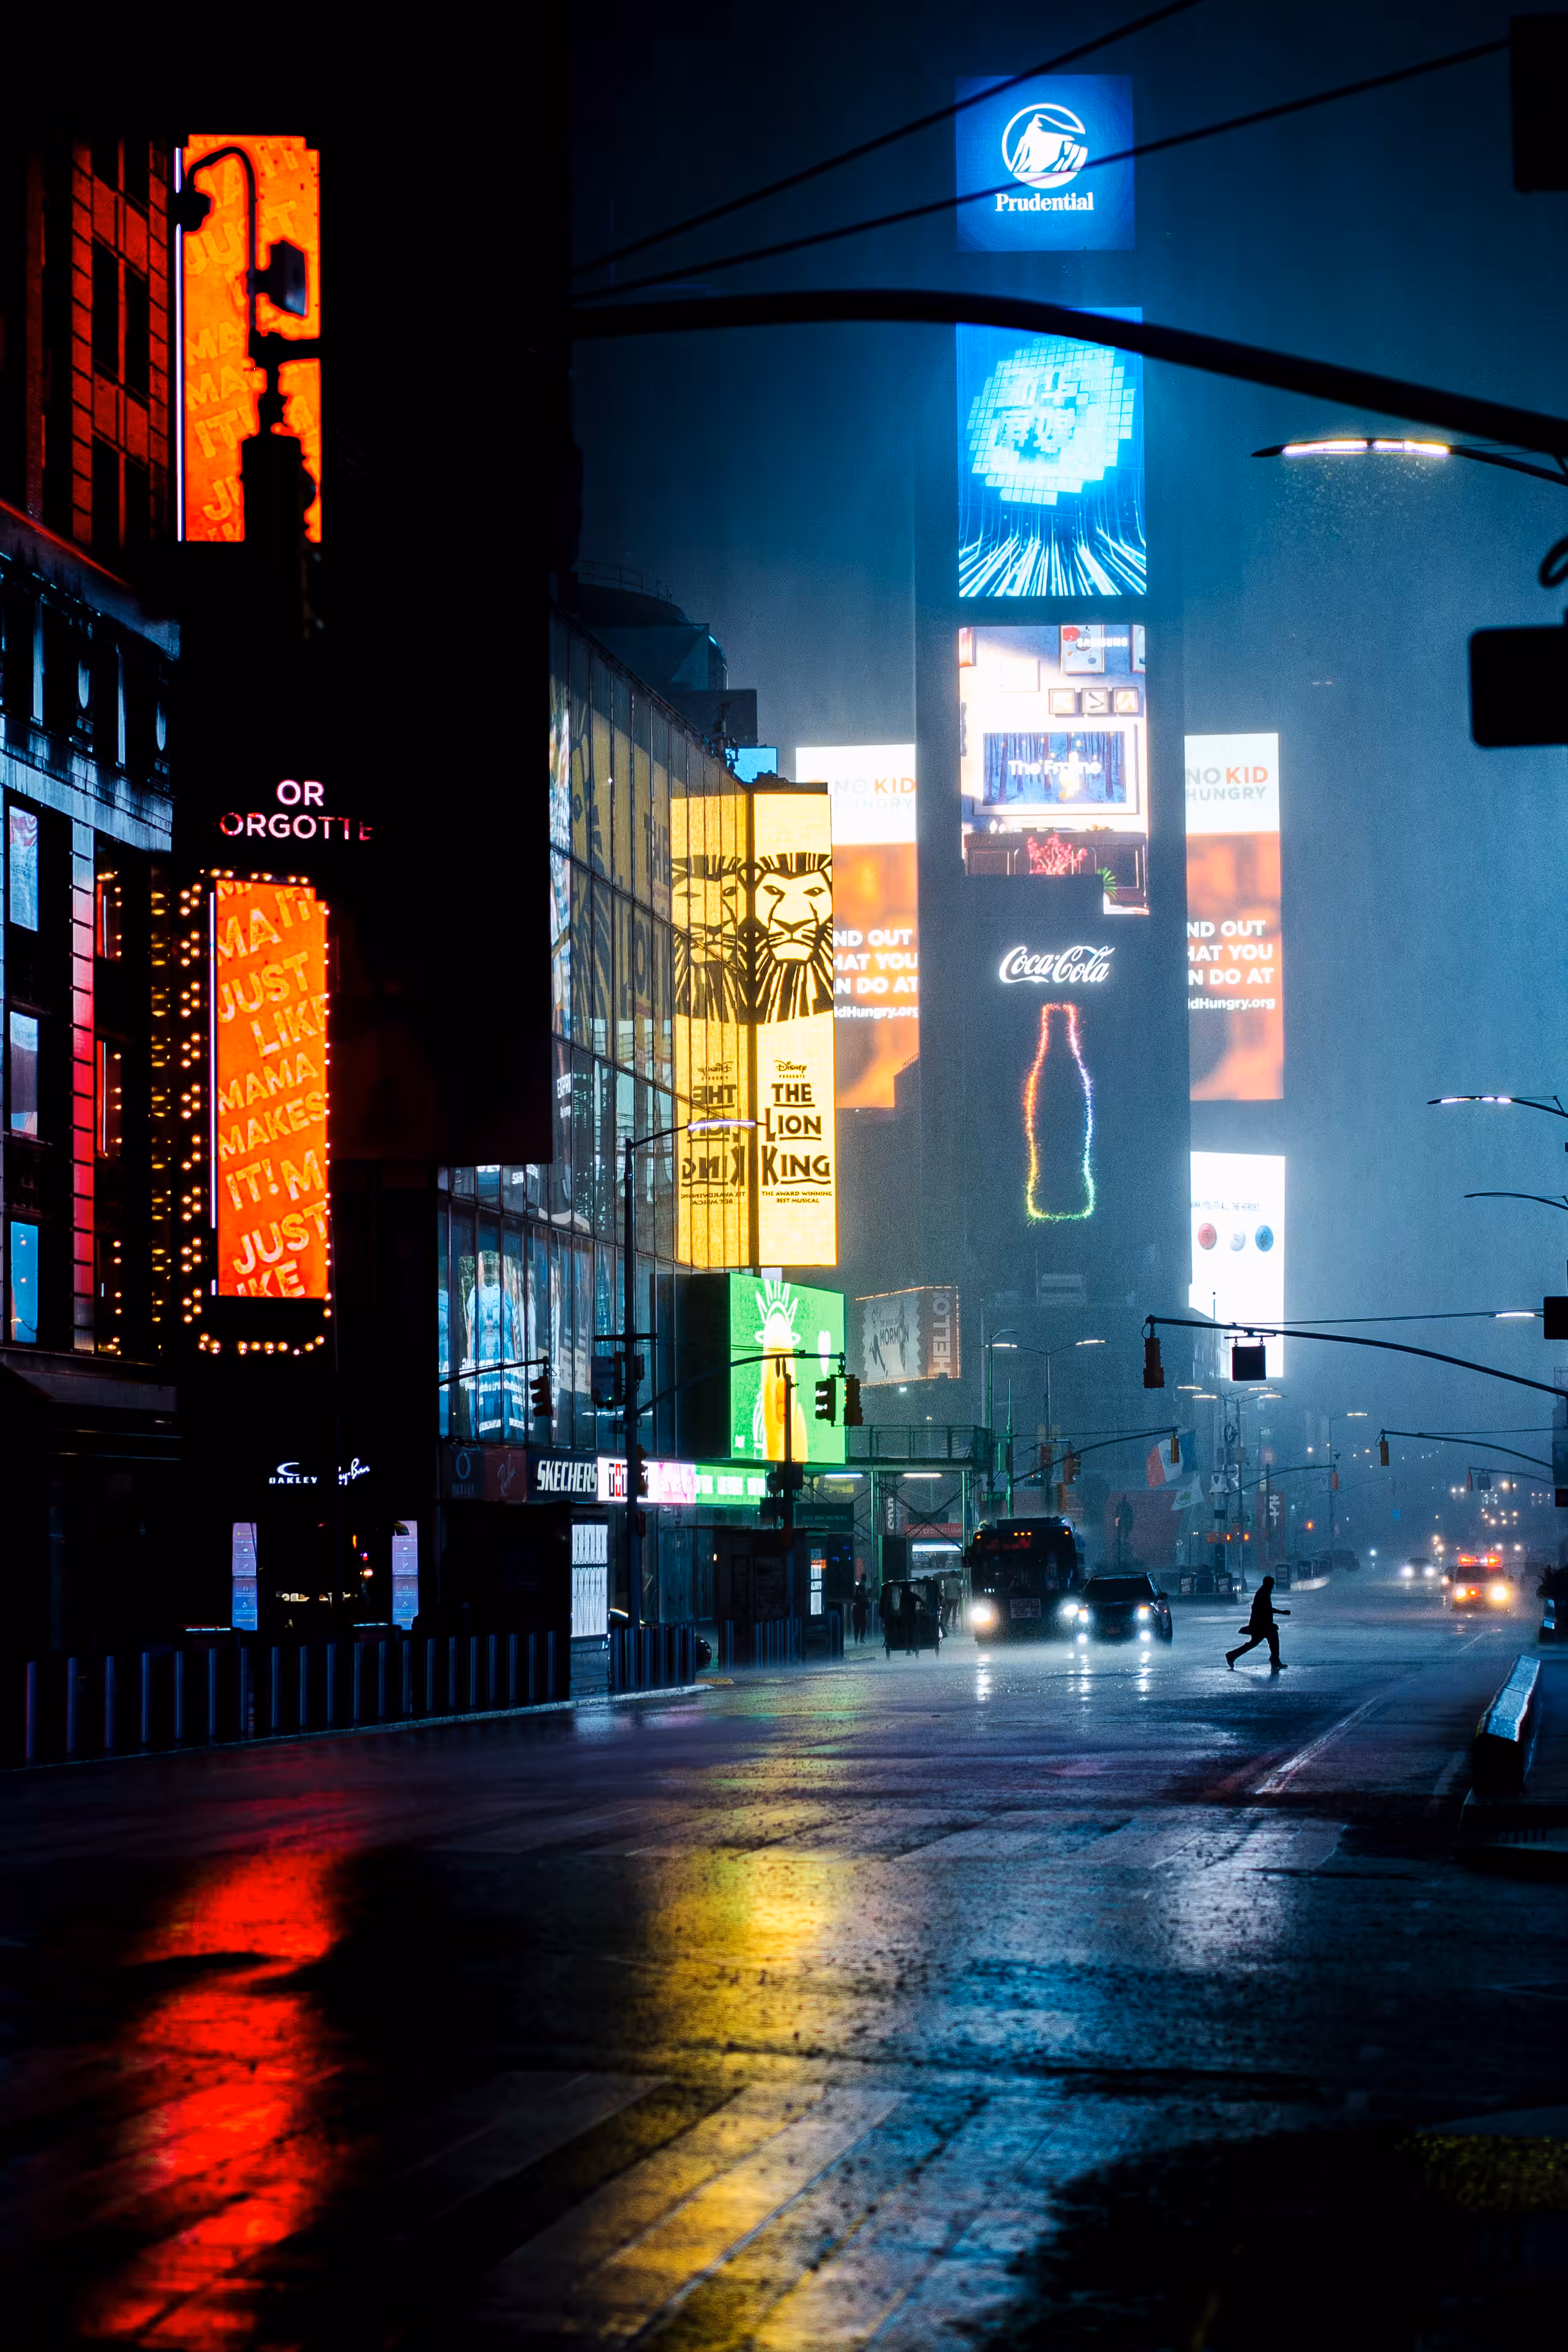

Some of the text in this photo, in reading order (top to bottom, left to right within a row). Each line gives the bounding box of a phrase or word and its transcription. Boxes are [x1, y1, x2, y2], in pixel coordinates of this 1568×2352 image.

[995, 192, 1094, 211] Prudential
[1076, 638, 1128, 647] SAUNG
[1008, 760, 1042, 776] The
[1186, 767, 1268, 785] NO KID
[277, 780, 324, 806] OR
[875, 777, 917, 794] KID
[1187, 786, 1268, 801] HUNGRY
[1220, 920, 1266, 936] OUT
[868, 929, 912, 946] OUT
[875, 952, 918, 969] YOU
[1228, 944, 1273, 960] YOU
[999, 945, 1115, 983] Coca-Cola
[857, 977, 888, 994] DO
[893, 976, 918, 993] AT
[1210, 968, 1241, 985] DO
[1247, 967, 1274, 984] AT
[218, 951, 308, 1023] JUST
[219, 1053, 318, 1117] MAMA
[771, 1083, 812, 1102] THE
[219, 1091, 325, 1162] MAKES
[765, 1108, 822, 1142] LION
[761, 1145, 831, 1186] KING
[232, 1200, 327, 1274] JUST
[537, 1461, 597, 1492] SKECHERS
